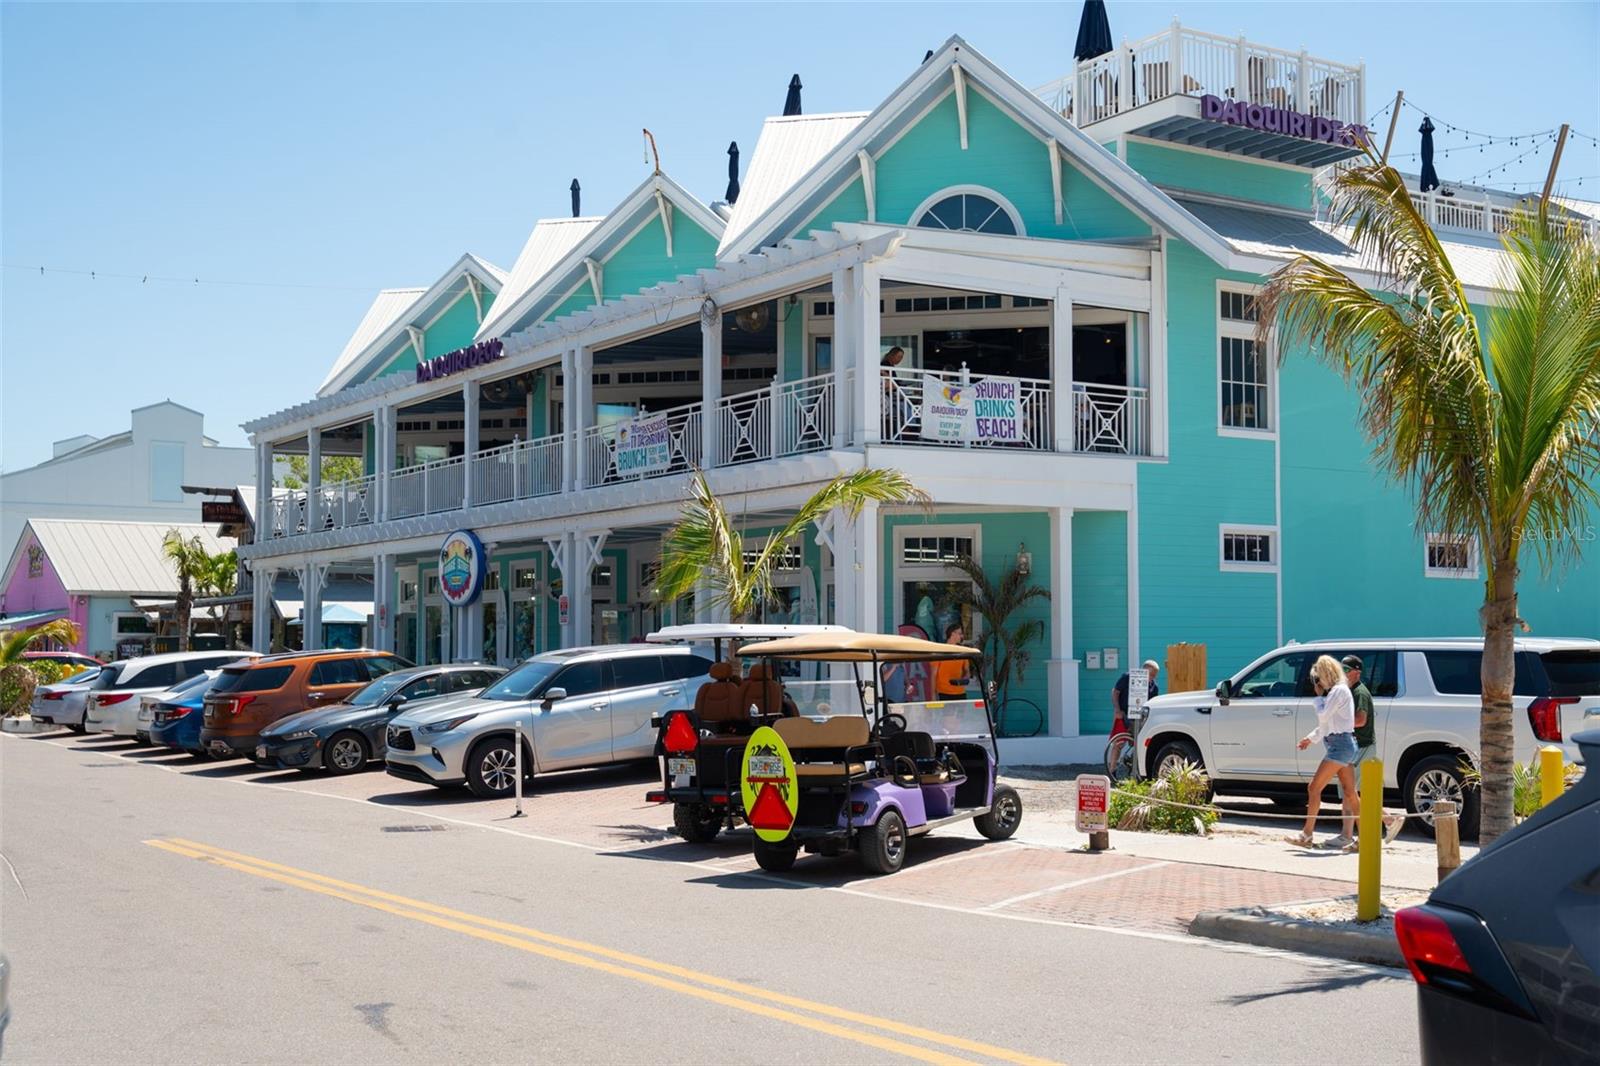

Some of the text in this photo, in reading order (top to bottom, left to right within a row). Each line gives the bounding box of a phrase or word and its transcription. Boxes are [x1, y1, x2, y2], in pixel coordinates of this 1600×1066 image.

[1201, 94, 1370, 148] DAIQUIRI DECK
[416, 348, 469, 384] DAIQUIRI
[974, 400, 1016, 418] DRINKS
[976, 418, 1016, 439] BEACH
[618, 448, 647, 471] BRUNCH
